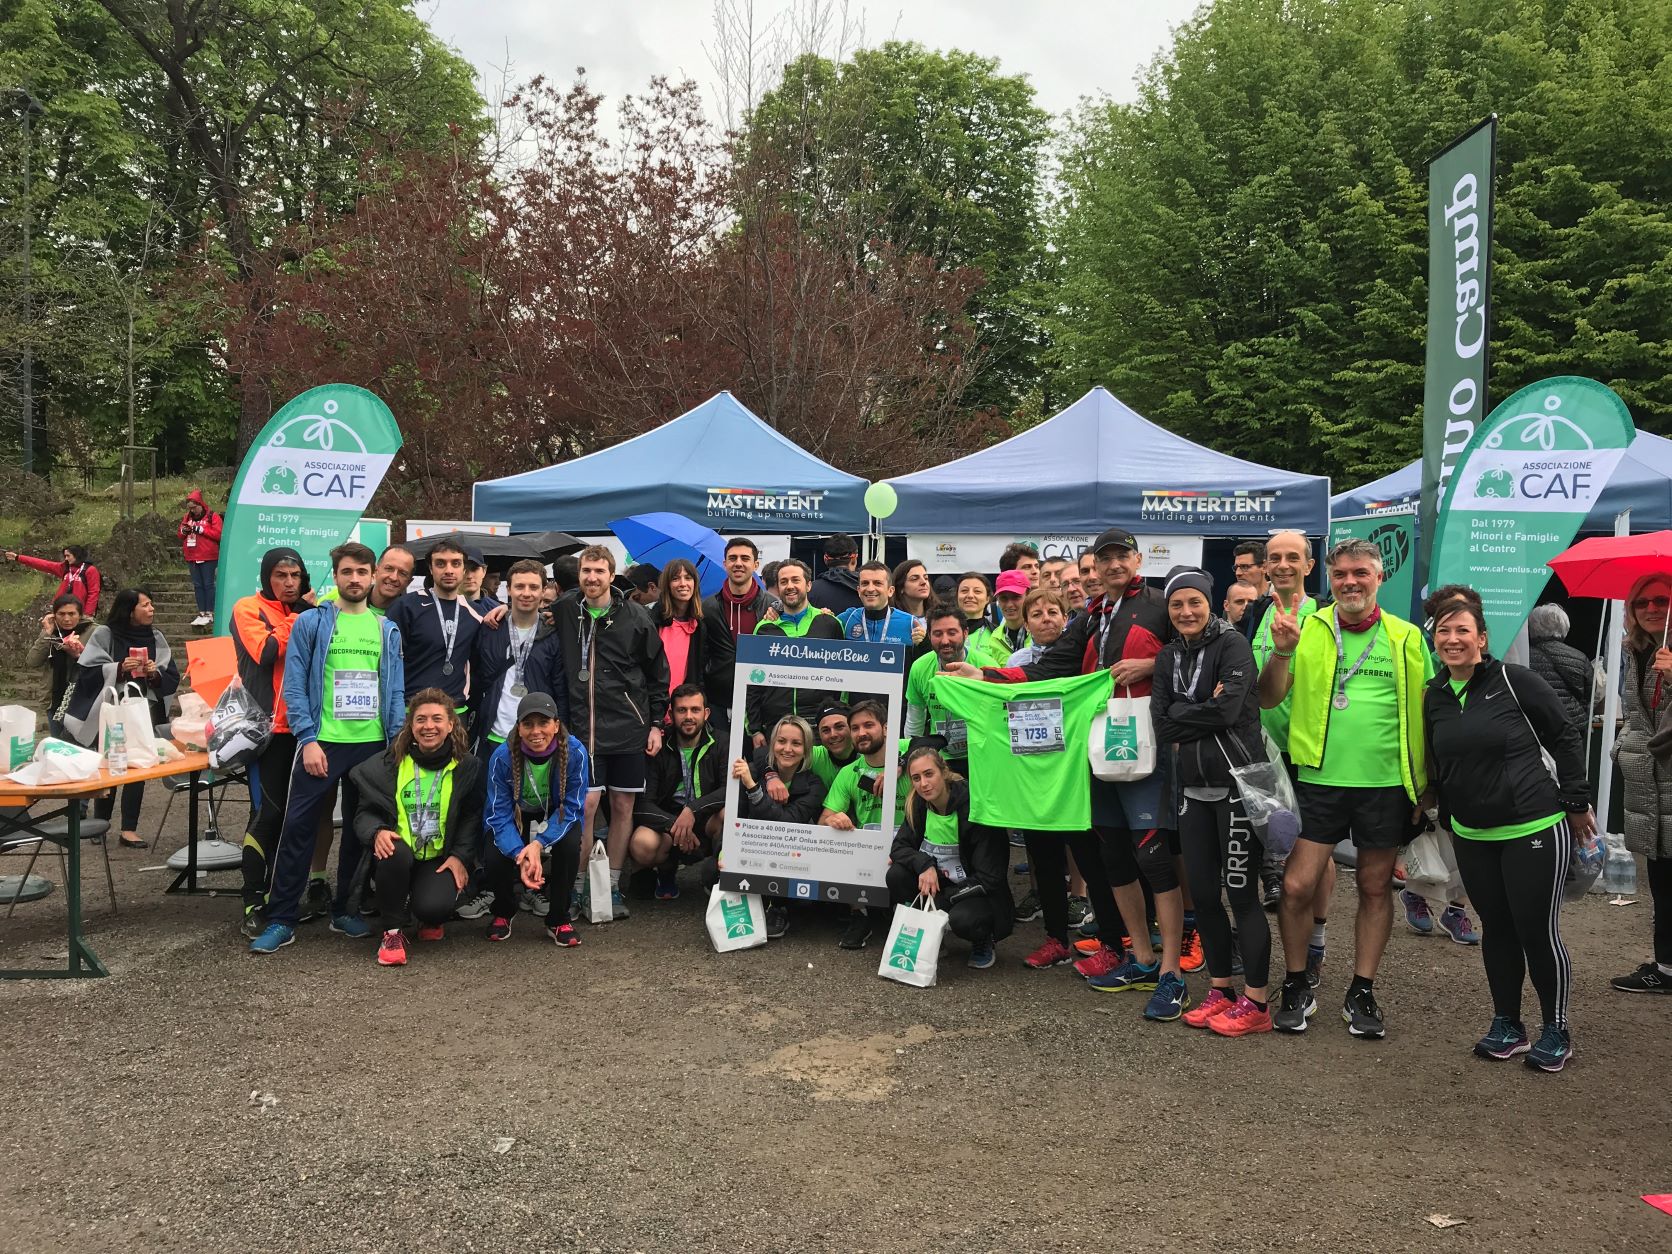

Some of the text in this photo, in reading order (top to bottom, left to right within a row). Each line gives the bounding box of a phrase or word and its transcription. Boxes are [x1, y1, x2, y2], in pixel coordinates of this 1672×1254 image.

[304, 461, 366, 471] ASSOCIAZIONE
[1522, 461, 1592, 470] ASSOCIAZIONE
[303, 472, 366, 498] CAF
[1520, 473, 1592, 499] CAF
[706, 494, 823, 510] MASTERTENT
[1141, 496, 1275, 512] MASTERTENT
[258, 513, 299, 523] Dal 1979
[707, 508, 824, 519] building up moments
[1141, 511, 1275, 523] building up moments
[1471, 518, 1515, 528] Dal 1979
[258, 525, 288, 535] Minori
[299, 527, 340, 538] Famiglie
[257, 537, 300, 546] al Centro
[1470, 531, 1503, 540] Minori
[1515, 532, 1560, 543] Famiglie
[1043, 543, 1089, 561] CAF
[1469, 543, 1516, 553] al Centro
[1469, 565, 1547, 575] www.caf-onlus.org
[768, 642, 870, 664] #40AnniperBene
[768, 672, 809, 681] Associazione
[742, 832, 782, 841] Associazione
[779, 864, 809, 872] Comment
